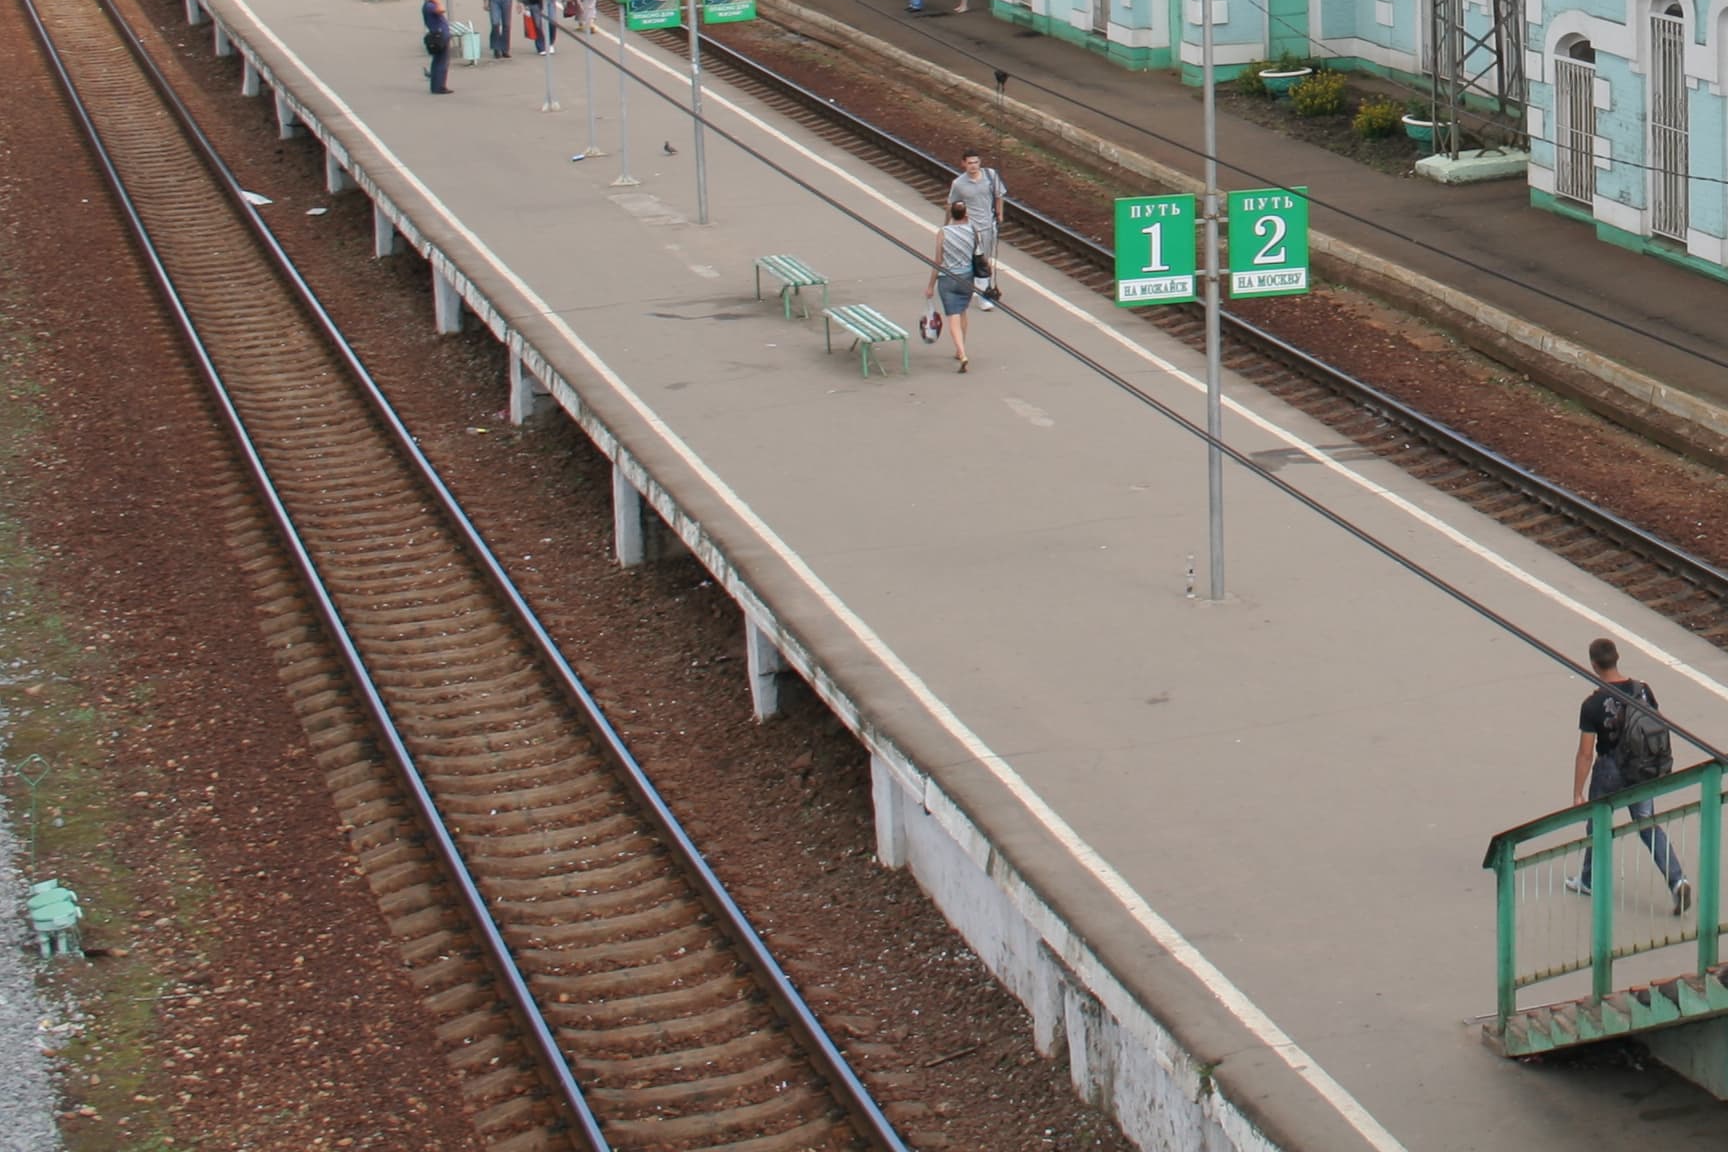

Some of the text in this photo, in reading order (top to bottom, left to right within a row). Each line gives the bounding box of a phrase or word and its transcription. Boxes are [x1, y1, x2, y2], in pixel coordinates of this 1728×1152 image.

[1130, 203, 1181, 218] ПУТЬ
[1243, 196, 1293, 211] ПУТЬ
[1141, 222, 1170, 272] 1
[1252, 215, 1287, 265] 2
[1124, 279, 1188, 297] НА МОЖАЙСК
[1238, 273, 1302, 289] НА МОСКВУ
